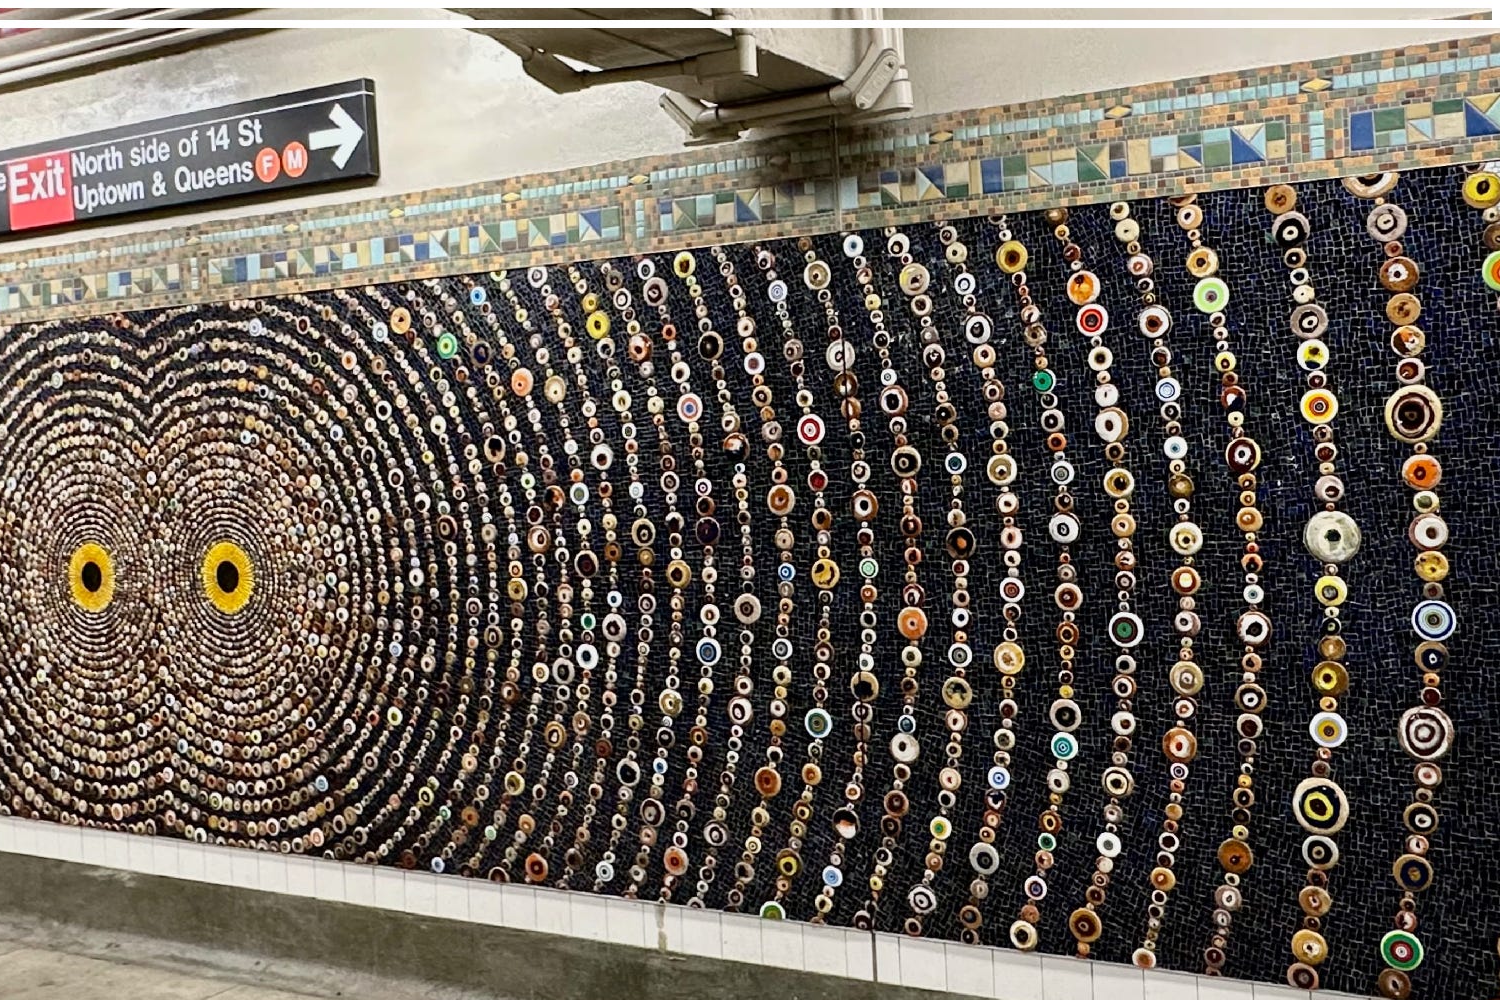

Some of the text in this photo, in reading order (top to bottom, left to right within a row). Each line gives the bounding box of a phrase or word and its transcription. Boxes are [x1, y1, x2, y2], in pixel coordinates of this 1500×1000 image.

[72, 118, 263, 178] North side of 14 St
[9, 158, 66, 205] Exit
[73, 149, 304, 214] Uptown & Queens F M
